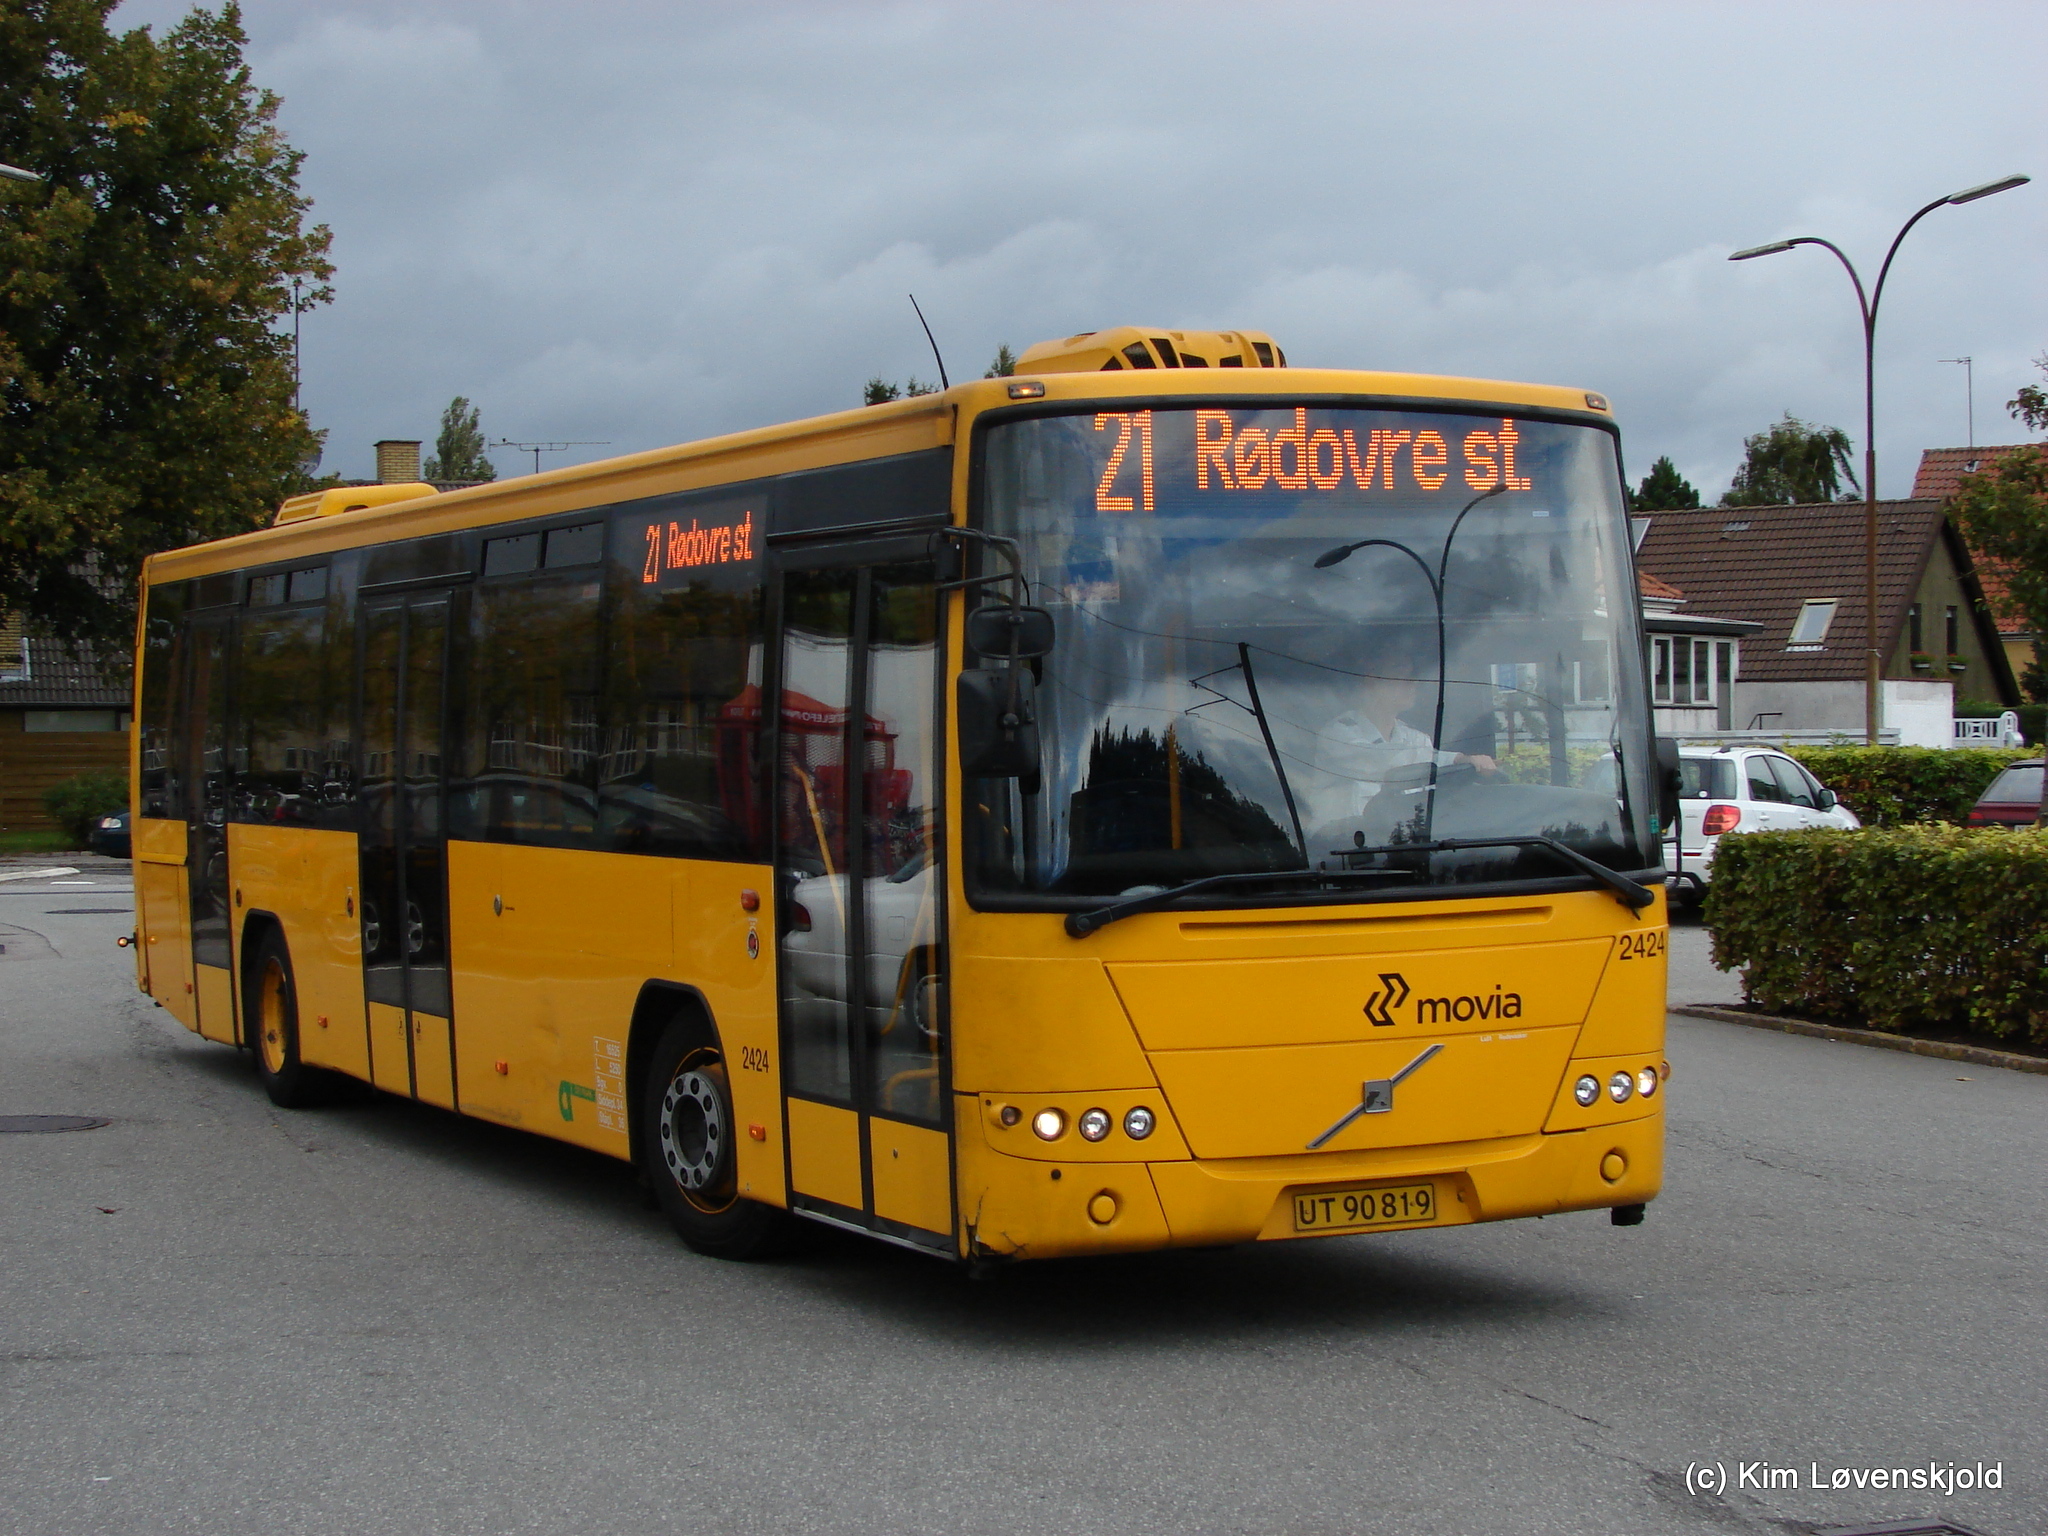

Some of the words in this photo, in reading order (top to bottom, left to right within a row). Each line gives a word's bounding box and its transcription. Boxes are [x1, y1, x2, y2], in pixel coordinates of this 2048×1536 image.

[1094, 409, 1154, 511] 21
[1196, 406, 1448, 490] Rødovre
[643, 523, 661, 584] 21
[666, 518, 731, 569] Rødovre
[1618, 931, 1665, 960] 2424
[1416, 983, 1522, 1024] movia
[741, 1046, 770, 1074] 2424
[1299, 1197, 1336, 1225] UT
